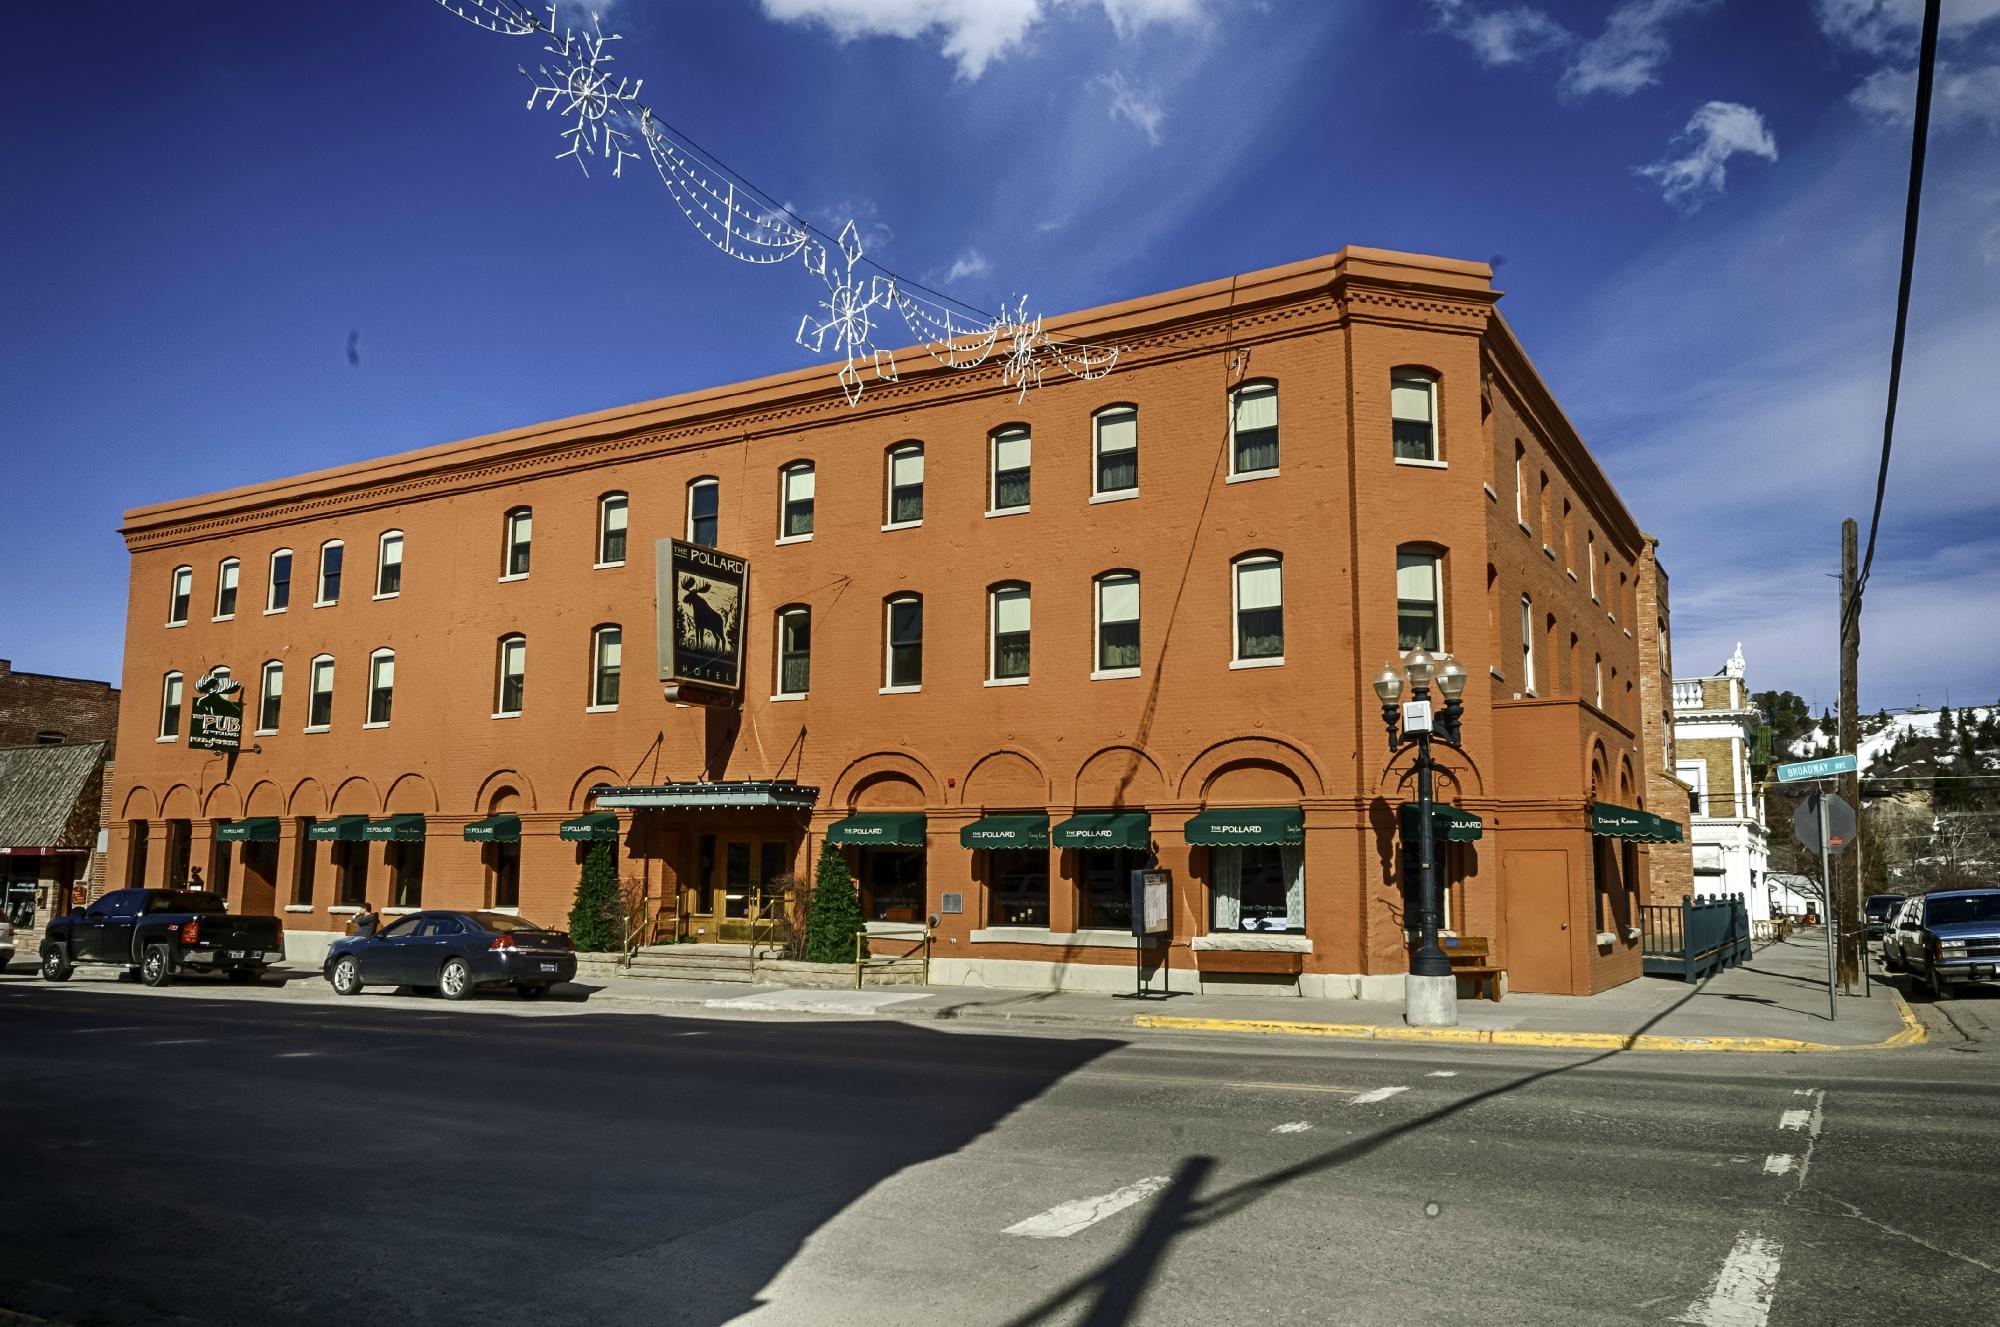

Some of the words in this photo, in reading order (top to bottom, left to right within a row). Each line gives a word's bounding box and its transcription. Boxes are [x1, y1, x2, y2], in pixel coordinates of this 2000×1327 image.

[673, 546, 688, 556] THE
[691, 549, 744, 574] POLLARD
[682, 665, 729, 682] HOTEL
[202, 714, 240, 732] PUB
[1787, 763, 1828, 777] BROADWAY
[1835, 762, 1846, 770] AVE
[1222, 825, 1262, 833] POLLARD
[1598, 817, 1619, 826] Dining
